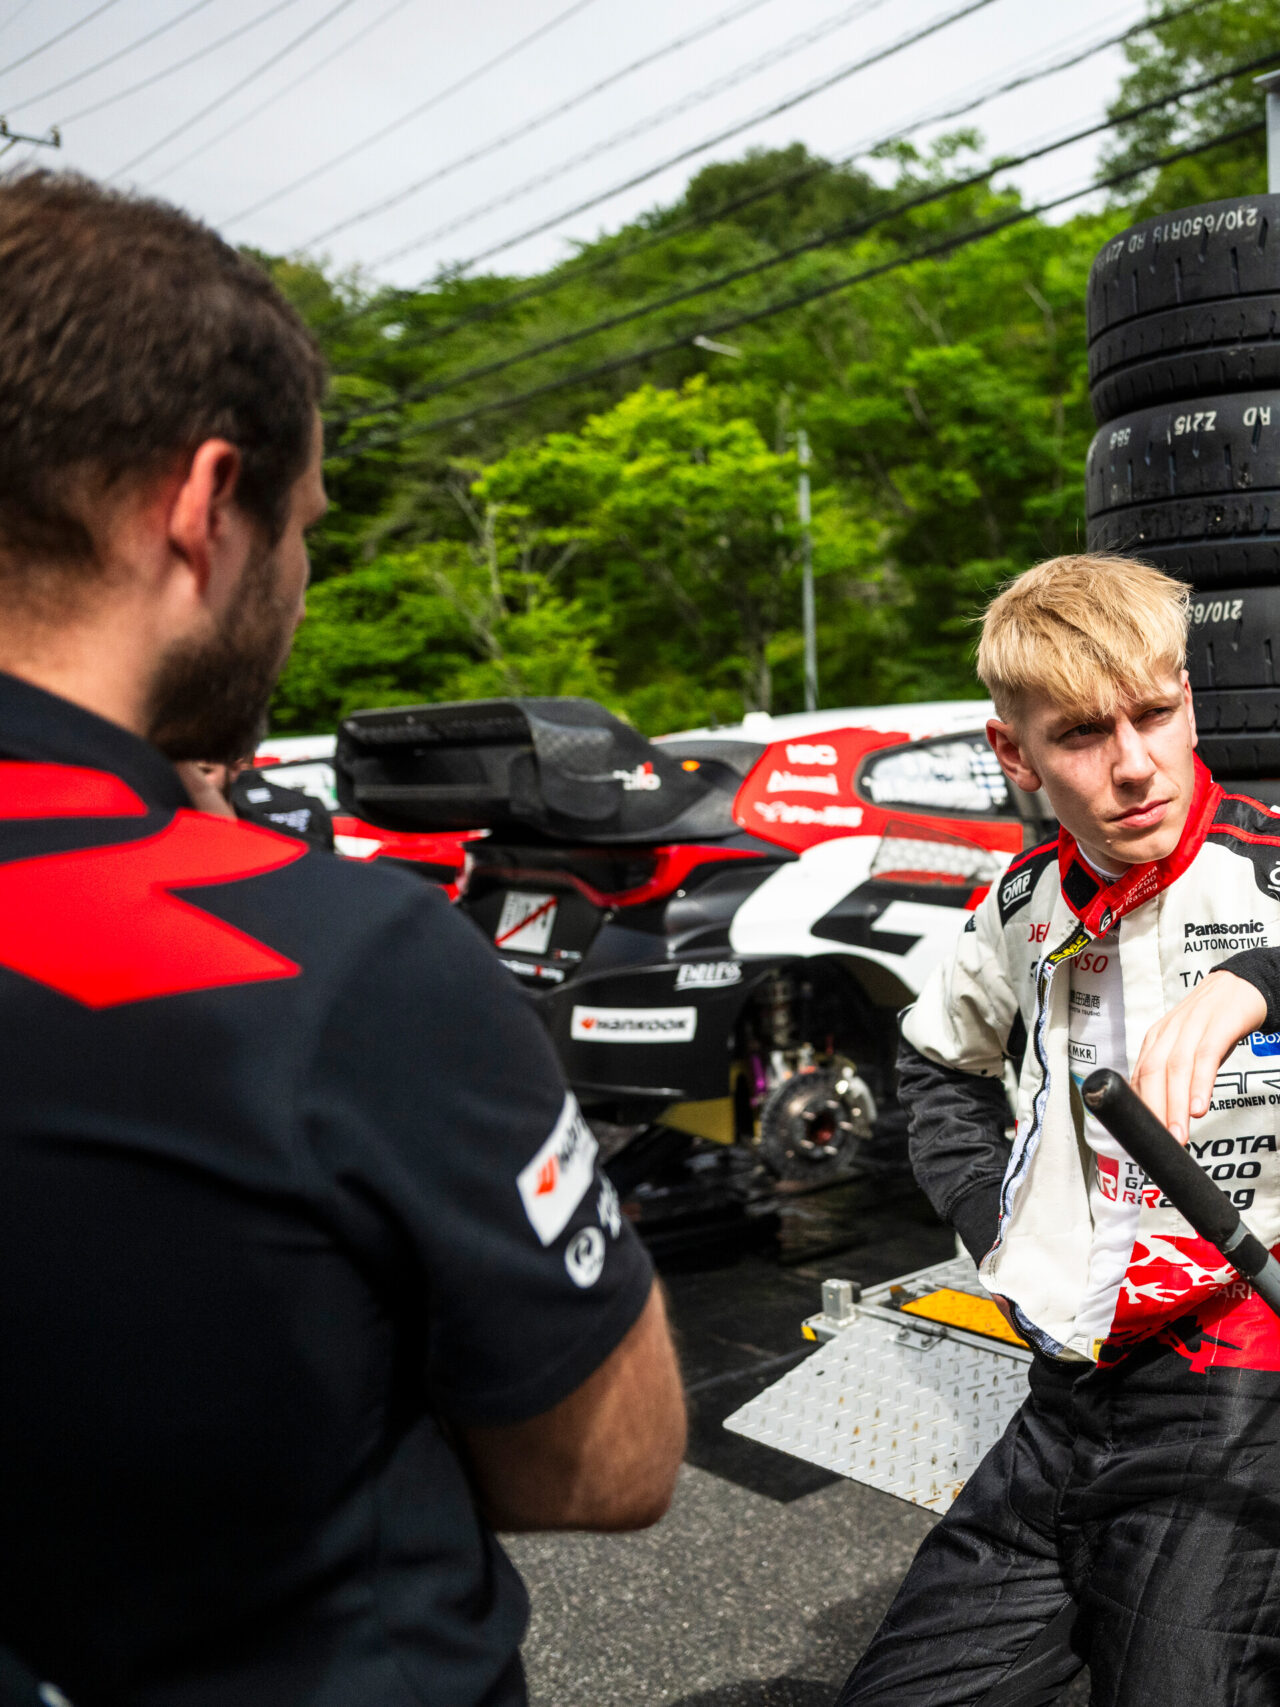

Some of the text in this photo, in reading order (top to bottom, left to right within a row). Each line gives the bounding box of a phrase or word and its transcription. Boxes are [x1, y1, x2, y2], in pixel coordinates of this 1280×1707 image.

[1153, 207, 1258, 243] 210/650R18
[1174, 411, 1216, 435] Z215
[1243, 406, 1271, 426] RD
[1003, 873, 1032, 903] OMP
[1125, 882, 1158, 907] Racing
[1184, 919, 1265, 938] Panasonic
[1183, 936, 1269, 954] AUTOMOTIVE
[1188, 1134, 1277, 1159] YOTA
